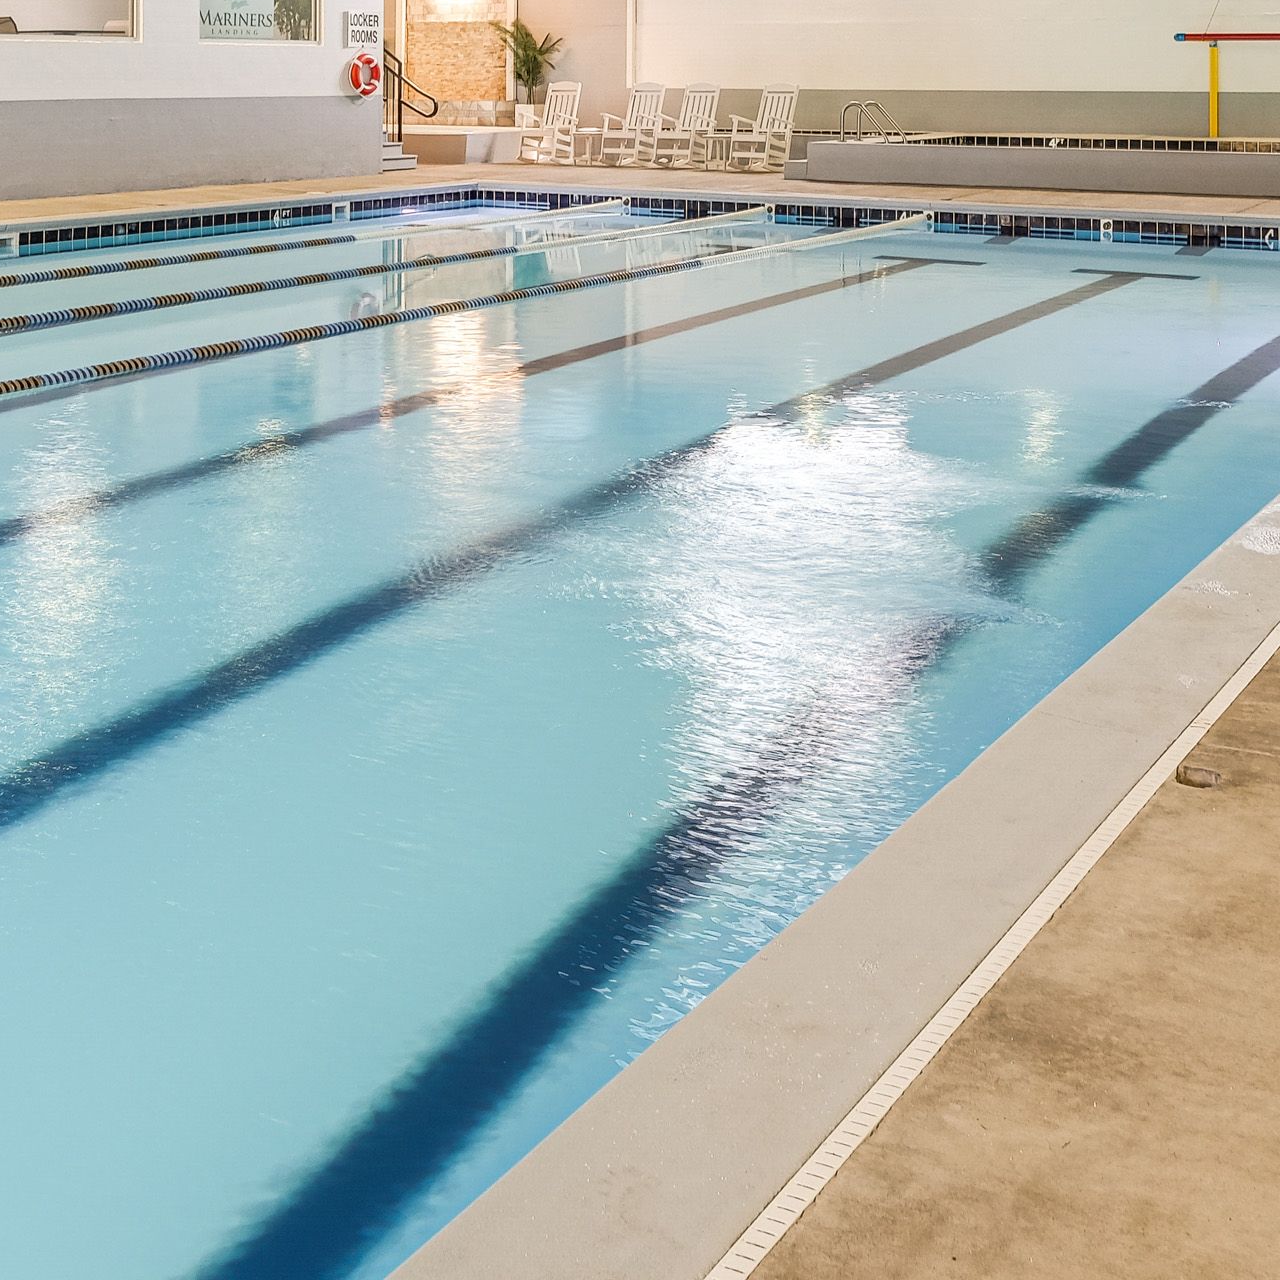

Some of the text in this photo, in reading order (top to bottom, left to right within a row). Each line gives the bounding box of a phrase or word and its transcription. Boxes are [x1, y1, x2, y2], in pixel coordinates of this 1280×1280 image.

[199, 9, 273, 28] MARINERS
[350, 13, 379, 27] LOCKER
[211, 28, 259, 36] LANDING
[351, 29, 378, 44] ROOMS
[282, 209, 291, 218] FT
